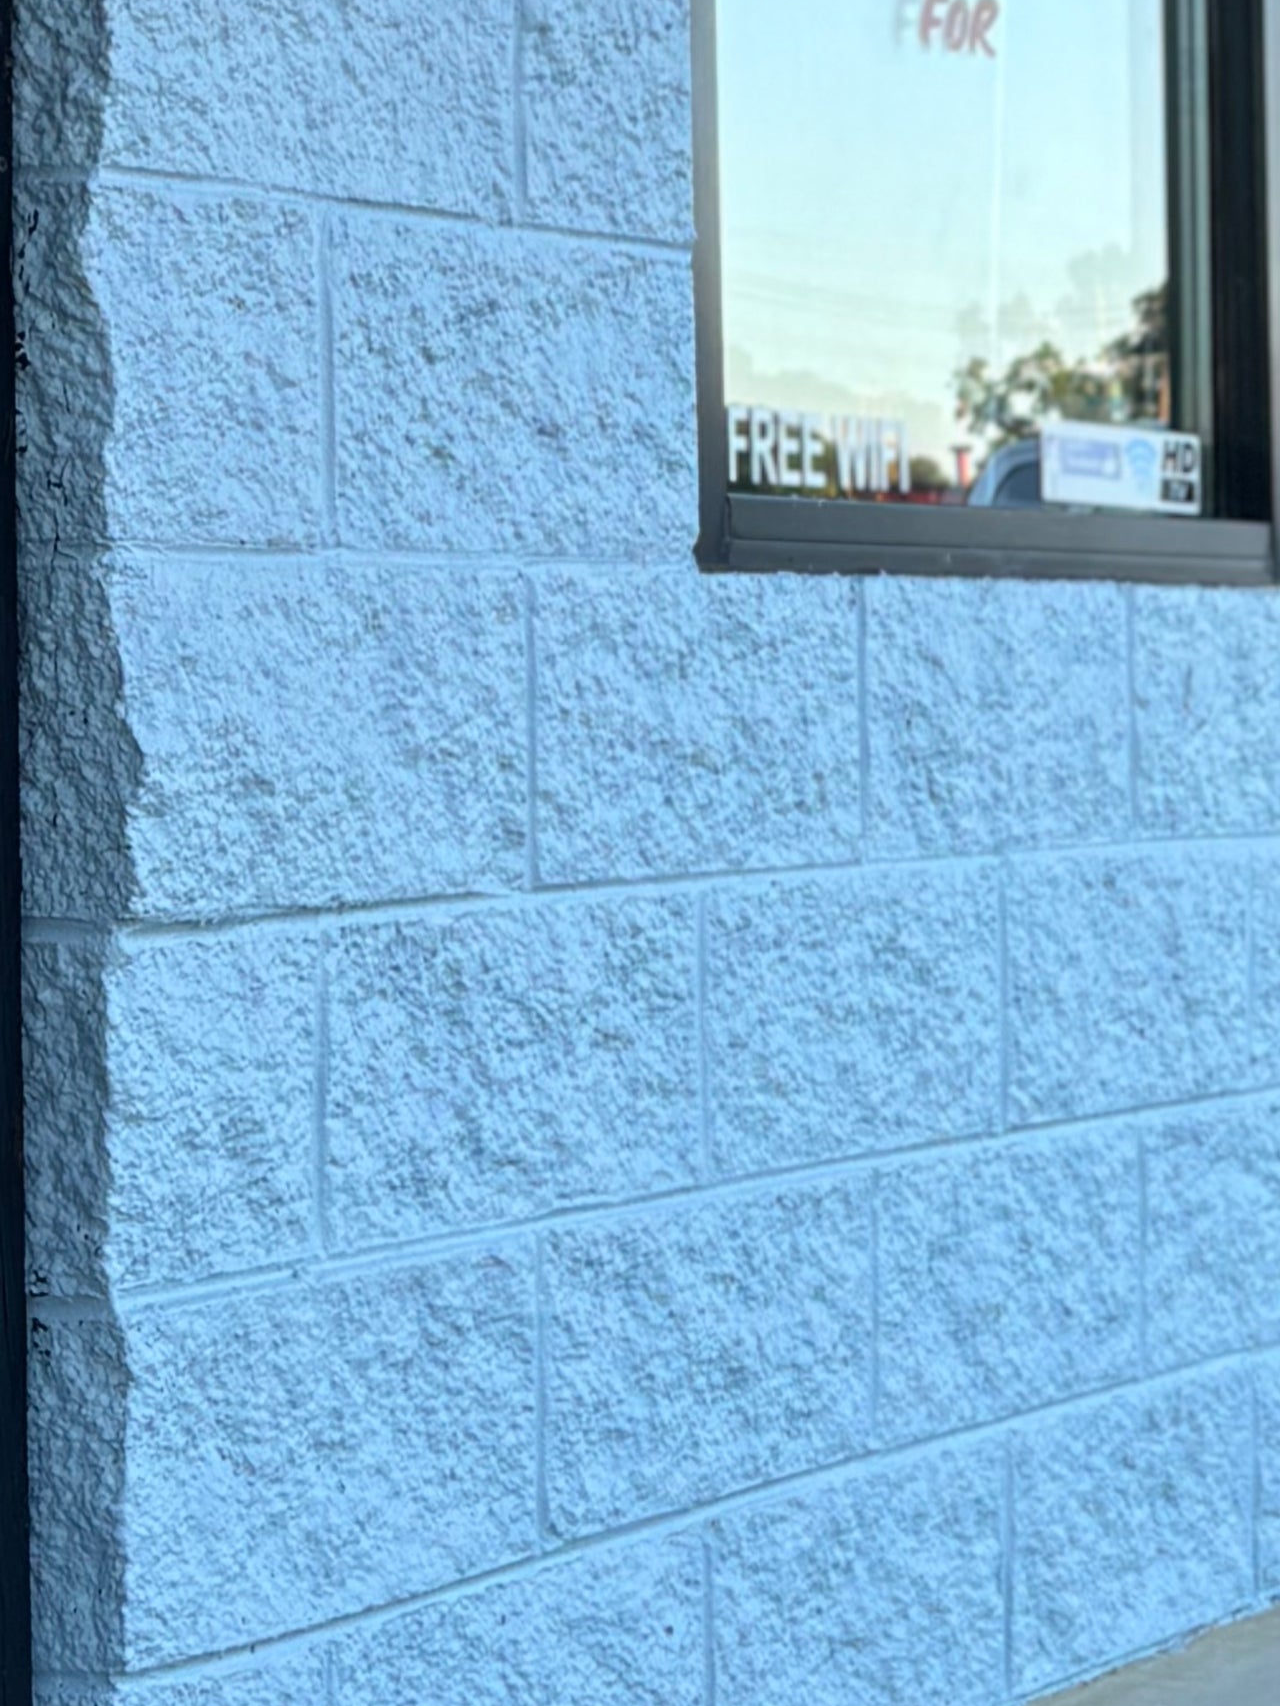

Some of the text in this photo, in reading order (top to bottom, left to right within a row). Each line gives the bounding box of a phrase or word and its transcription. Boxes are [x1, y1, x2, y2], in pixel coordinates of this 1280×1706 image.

[726, 404, 911, 493] FREE WIFI
[1162, 440, 1197, 474] HD
